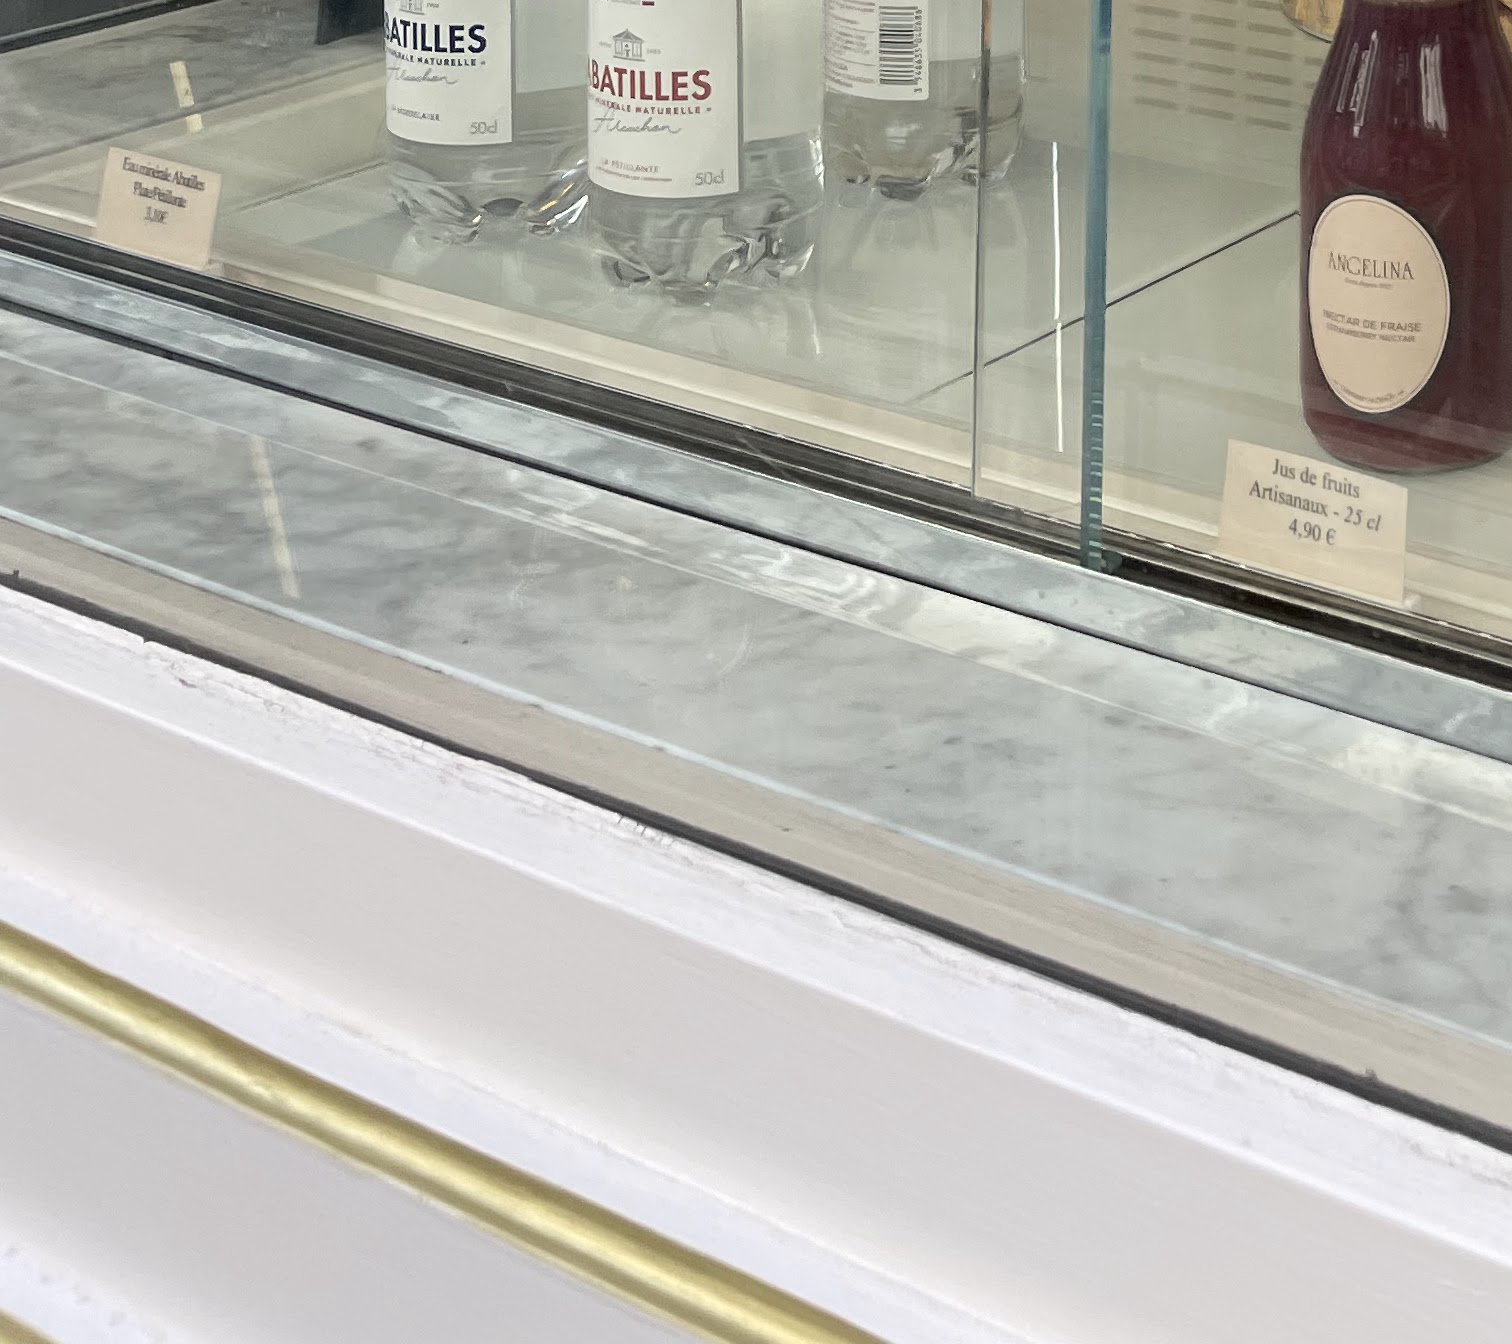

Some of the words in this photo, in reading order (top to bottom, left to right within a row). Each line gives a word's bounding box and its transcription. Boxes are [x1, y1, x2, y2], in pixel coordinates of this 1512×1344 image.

[587, 57, 712, 101] BATILLES
[635, 105, 702, 116] NATURELLE
[1328, 250, 1415, 281] ANGELINA
[1362, 319, 1379, 331] DE
[1272, 458, 1296, 480] Jus
[1299, 466, 1317, 486] de
[1322, 470, 1361, 499] fruits
[1248, 479, 1329, 518] Artisanaux
[1343, 505, 1363, 526] 25
[1366, 514, 1382, 532] cl
[1288, 518, 1323, 543] 4,90
[1325, 527, 1338, 546] €
